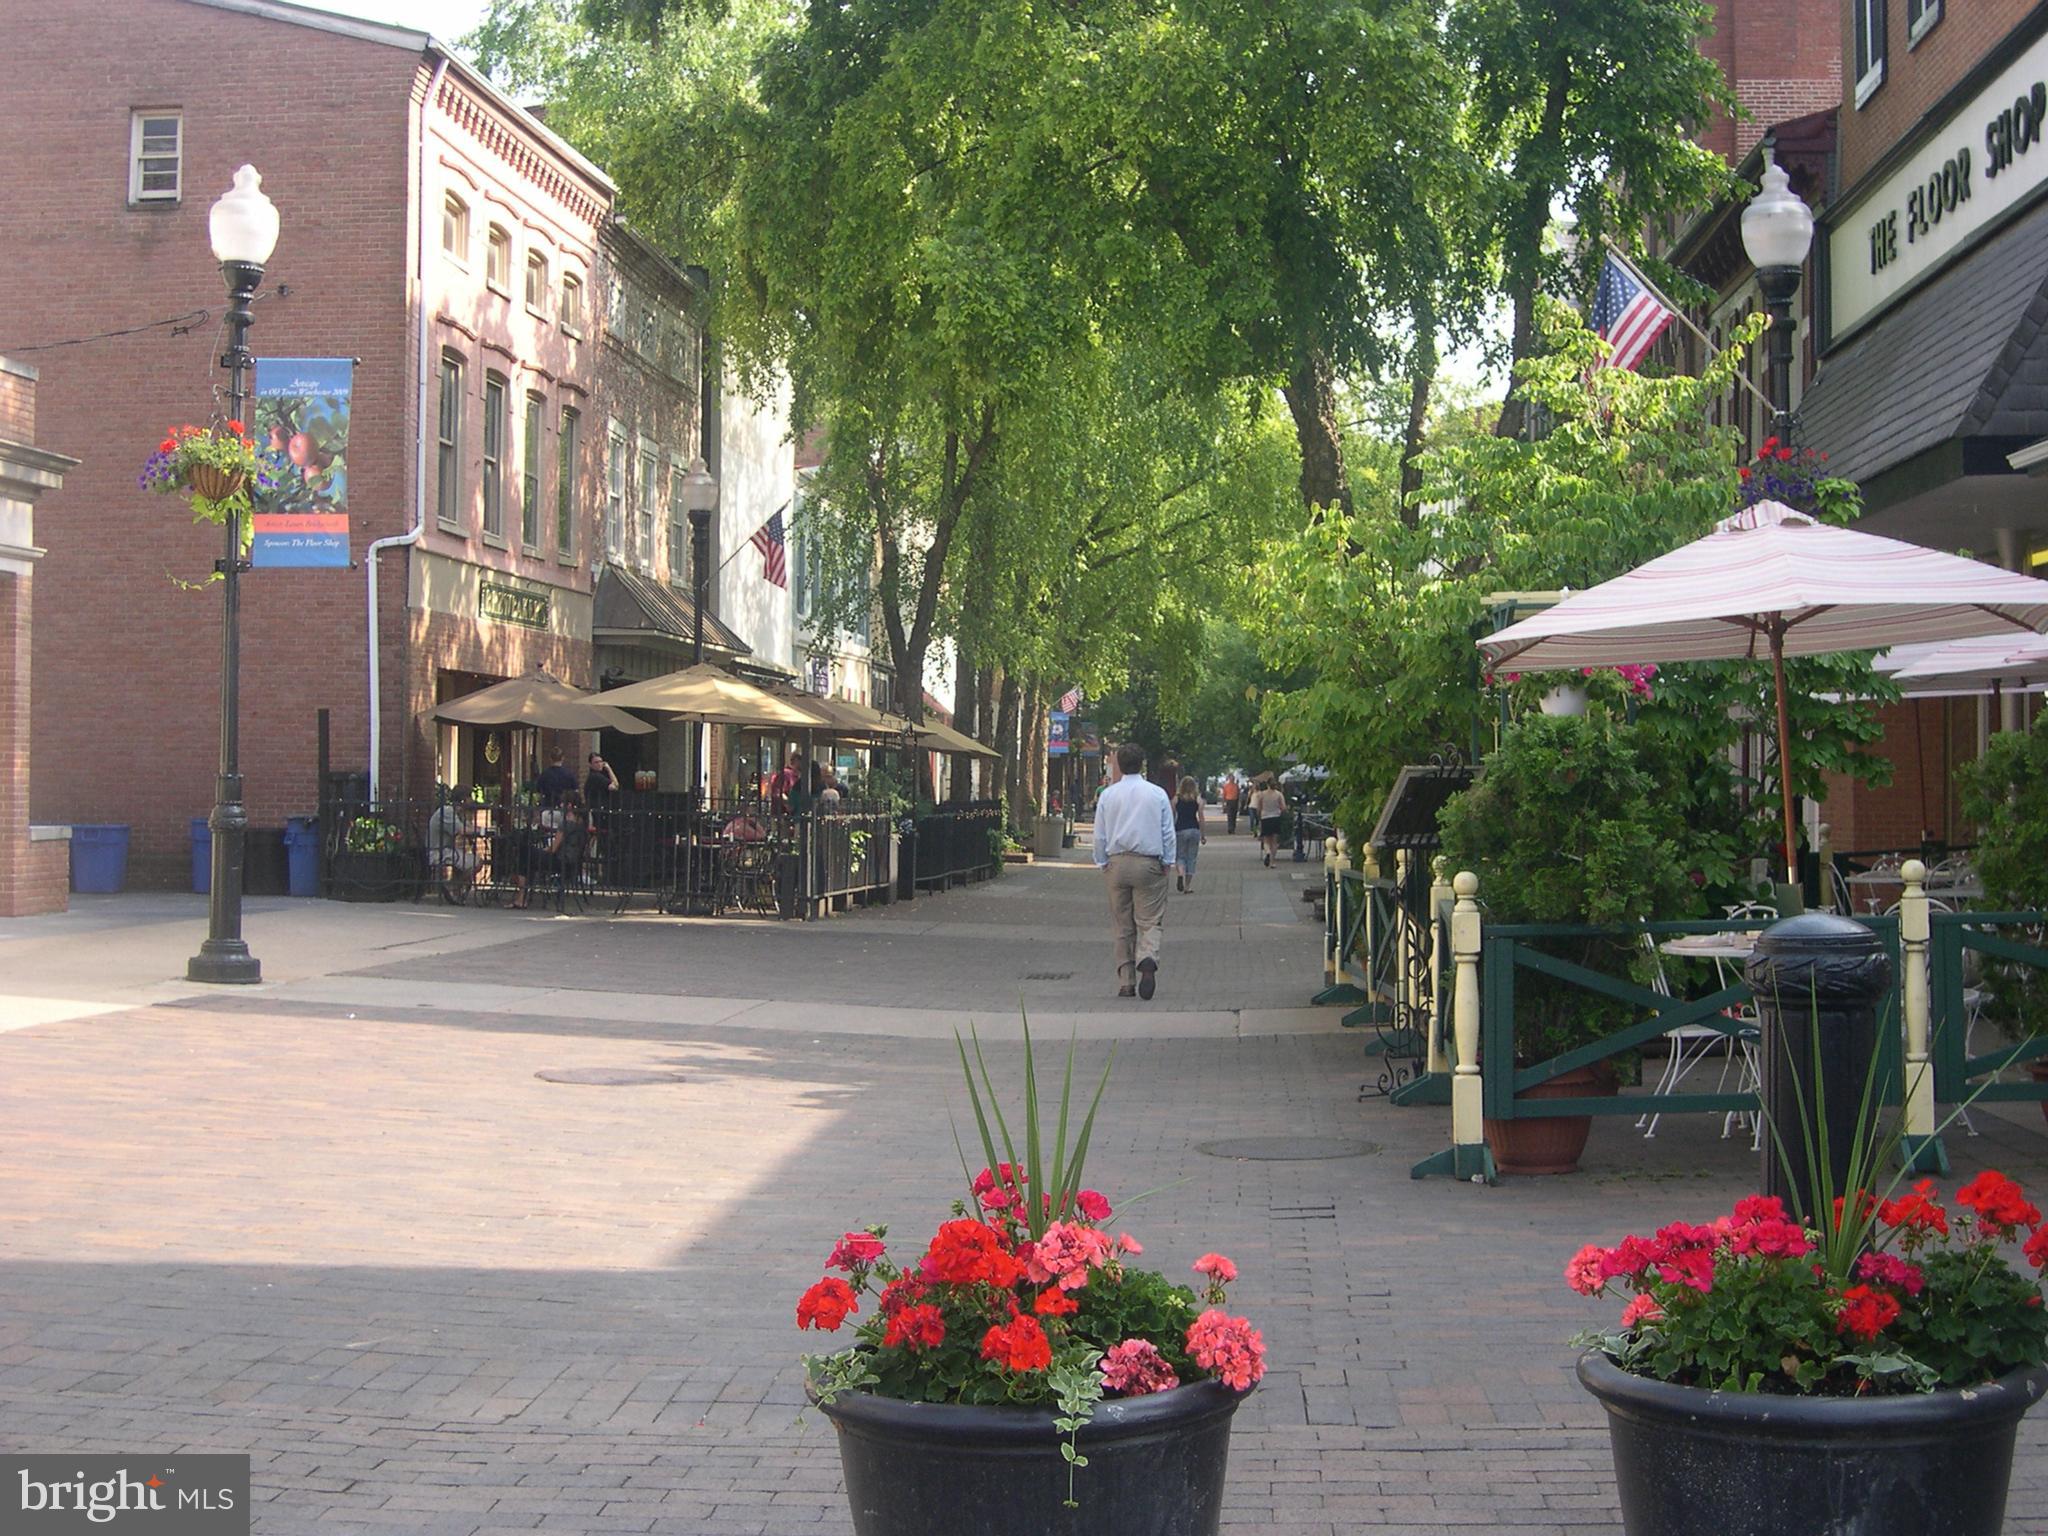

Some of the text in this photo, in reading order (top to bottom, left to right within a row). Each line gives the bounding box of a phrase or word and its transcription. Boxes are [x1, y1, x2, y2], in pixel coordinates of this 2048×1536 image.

[1868, 81, 2047, 275] THE FLOOR SHOP
[291, 539, 305, 547] The
[323, 539, 340, 548] Shop
